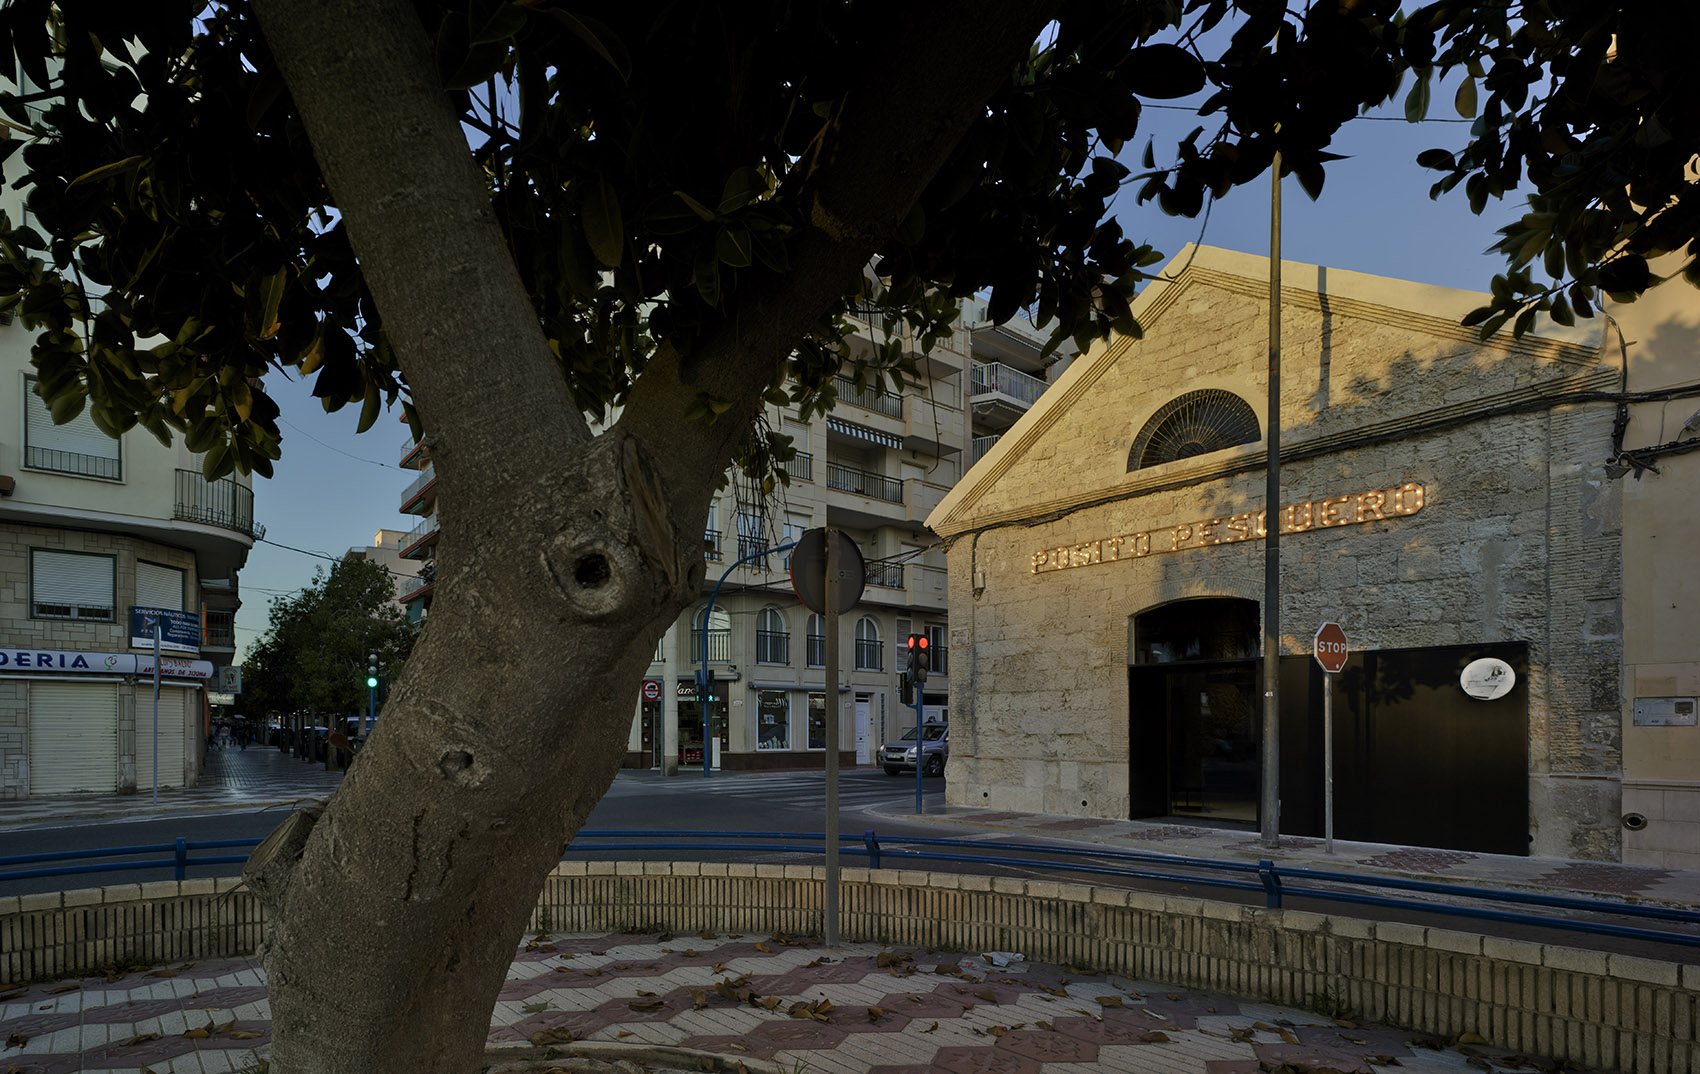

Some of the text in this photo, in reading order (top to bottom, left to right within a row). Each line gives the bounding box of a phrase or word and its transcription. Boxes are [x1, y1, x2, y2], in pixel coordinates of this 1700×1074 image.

[1031, 531, 1151, 574] POSITO
[135, 608, 162, 616] SERVICIOS
[1318, 641, 1346, 654] STOP
[143, 667, 175, 676] ARTANOS
